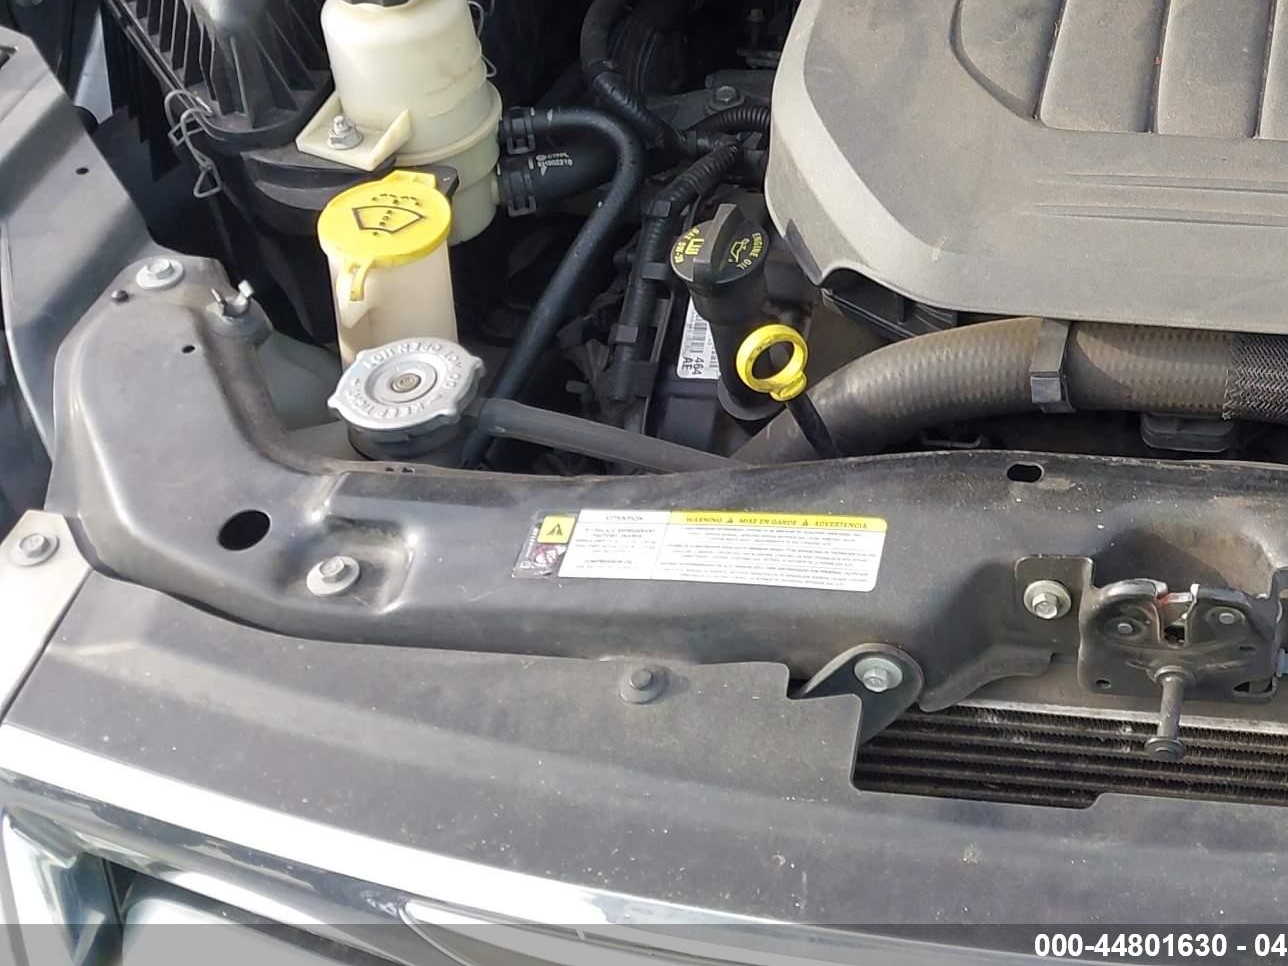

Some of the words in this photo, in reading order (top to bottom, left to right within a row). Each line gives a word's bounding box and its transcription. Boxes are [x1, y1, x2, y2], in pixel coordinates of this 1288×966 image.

[750, 232, 762, 258] ENGINE
[736, 258, 752, 270] OIL
[682, 356, 694, 370] AE
